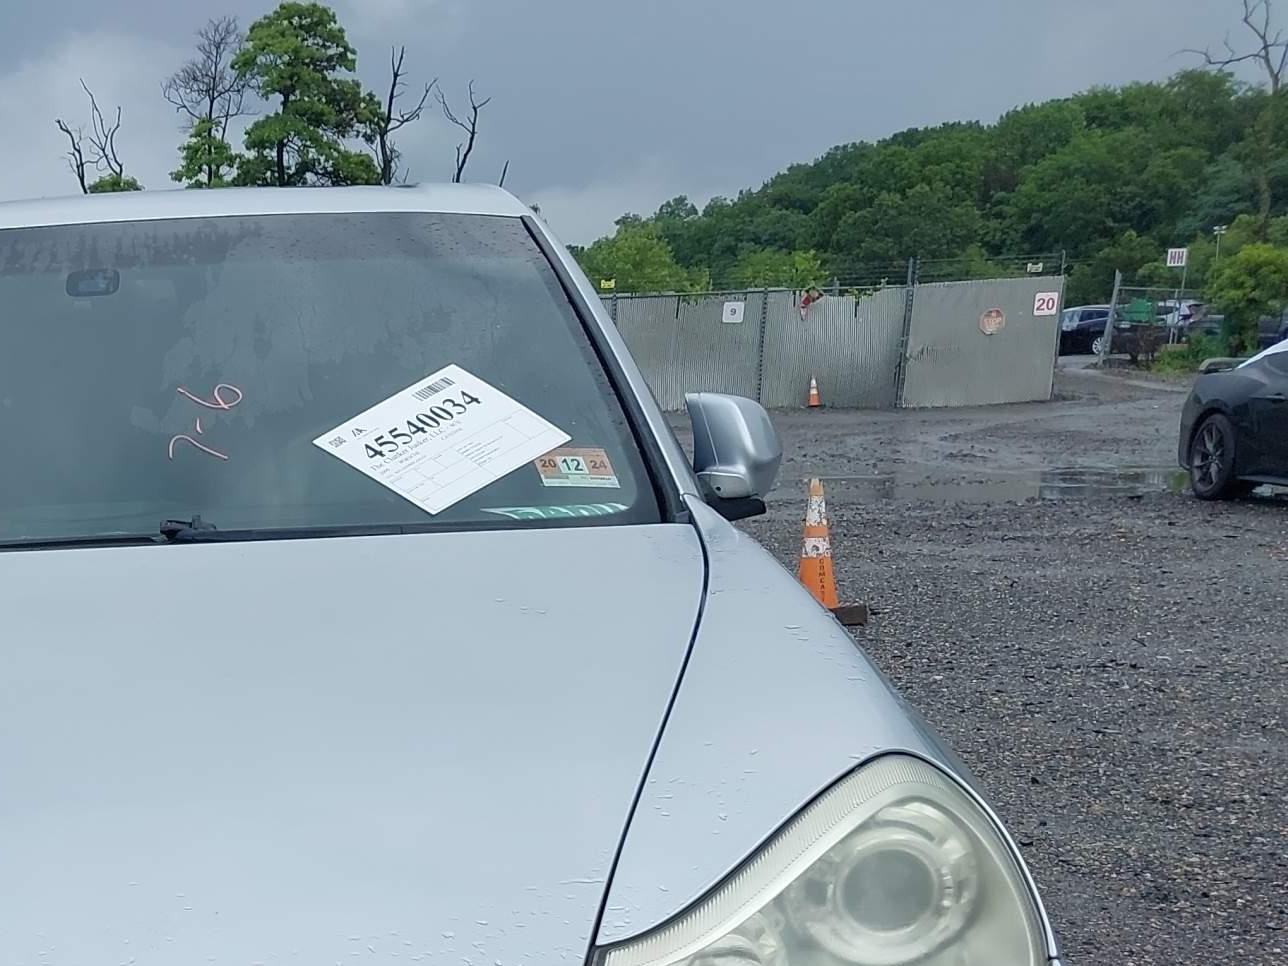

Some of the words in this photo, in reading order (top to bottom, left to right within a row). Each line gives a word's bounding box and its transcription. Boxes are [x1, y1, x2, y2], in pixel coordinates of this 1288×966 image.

[1169, 251, 1184, 265] HH
[1036, 298, 1055, 311] 20
[363, 389, 481, 460] 45540034
[539, 458, 557, 469] 20
[562, 458, 583, 472] 12
